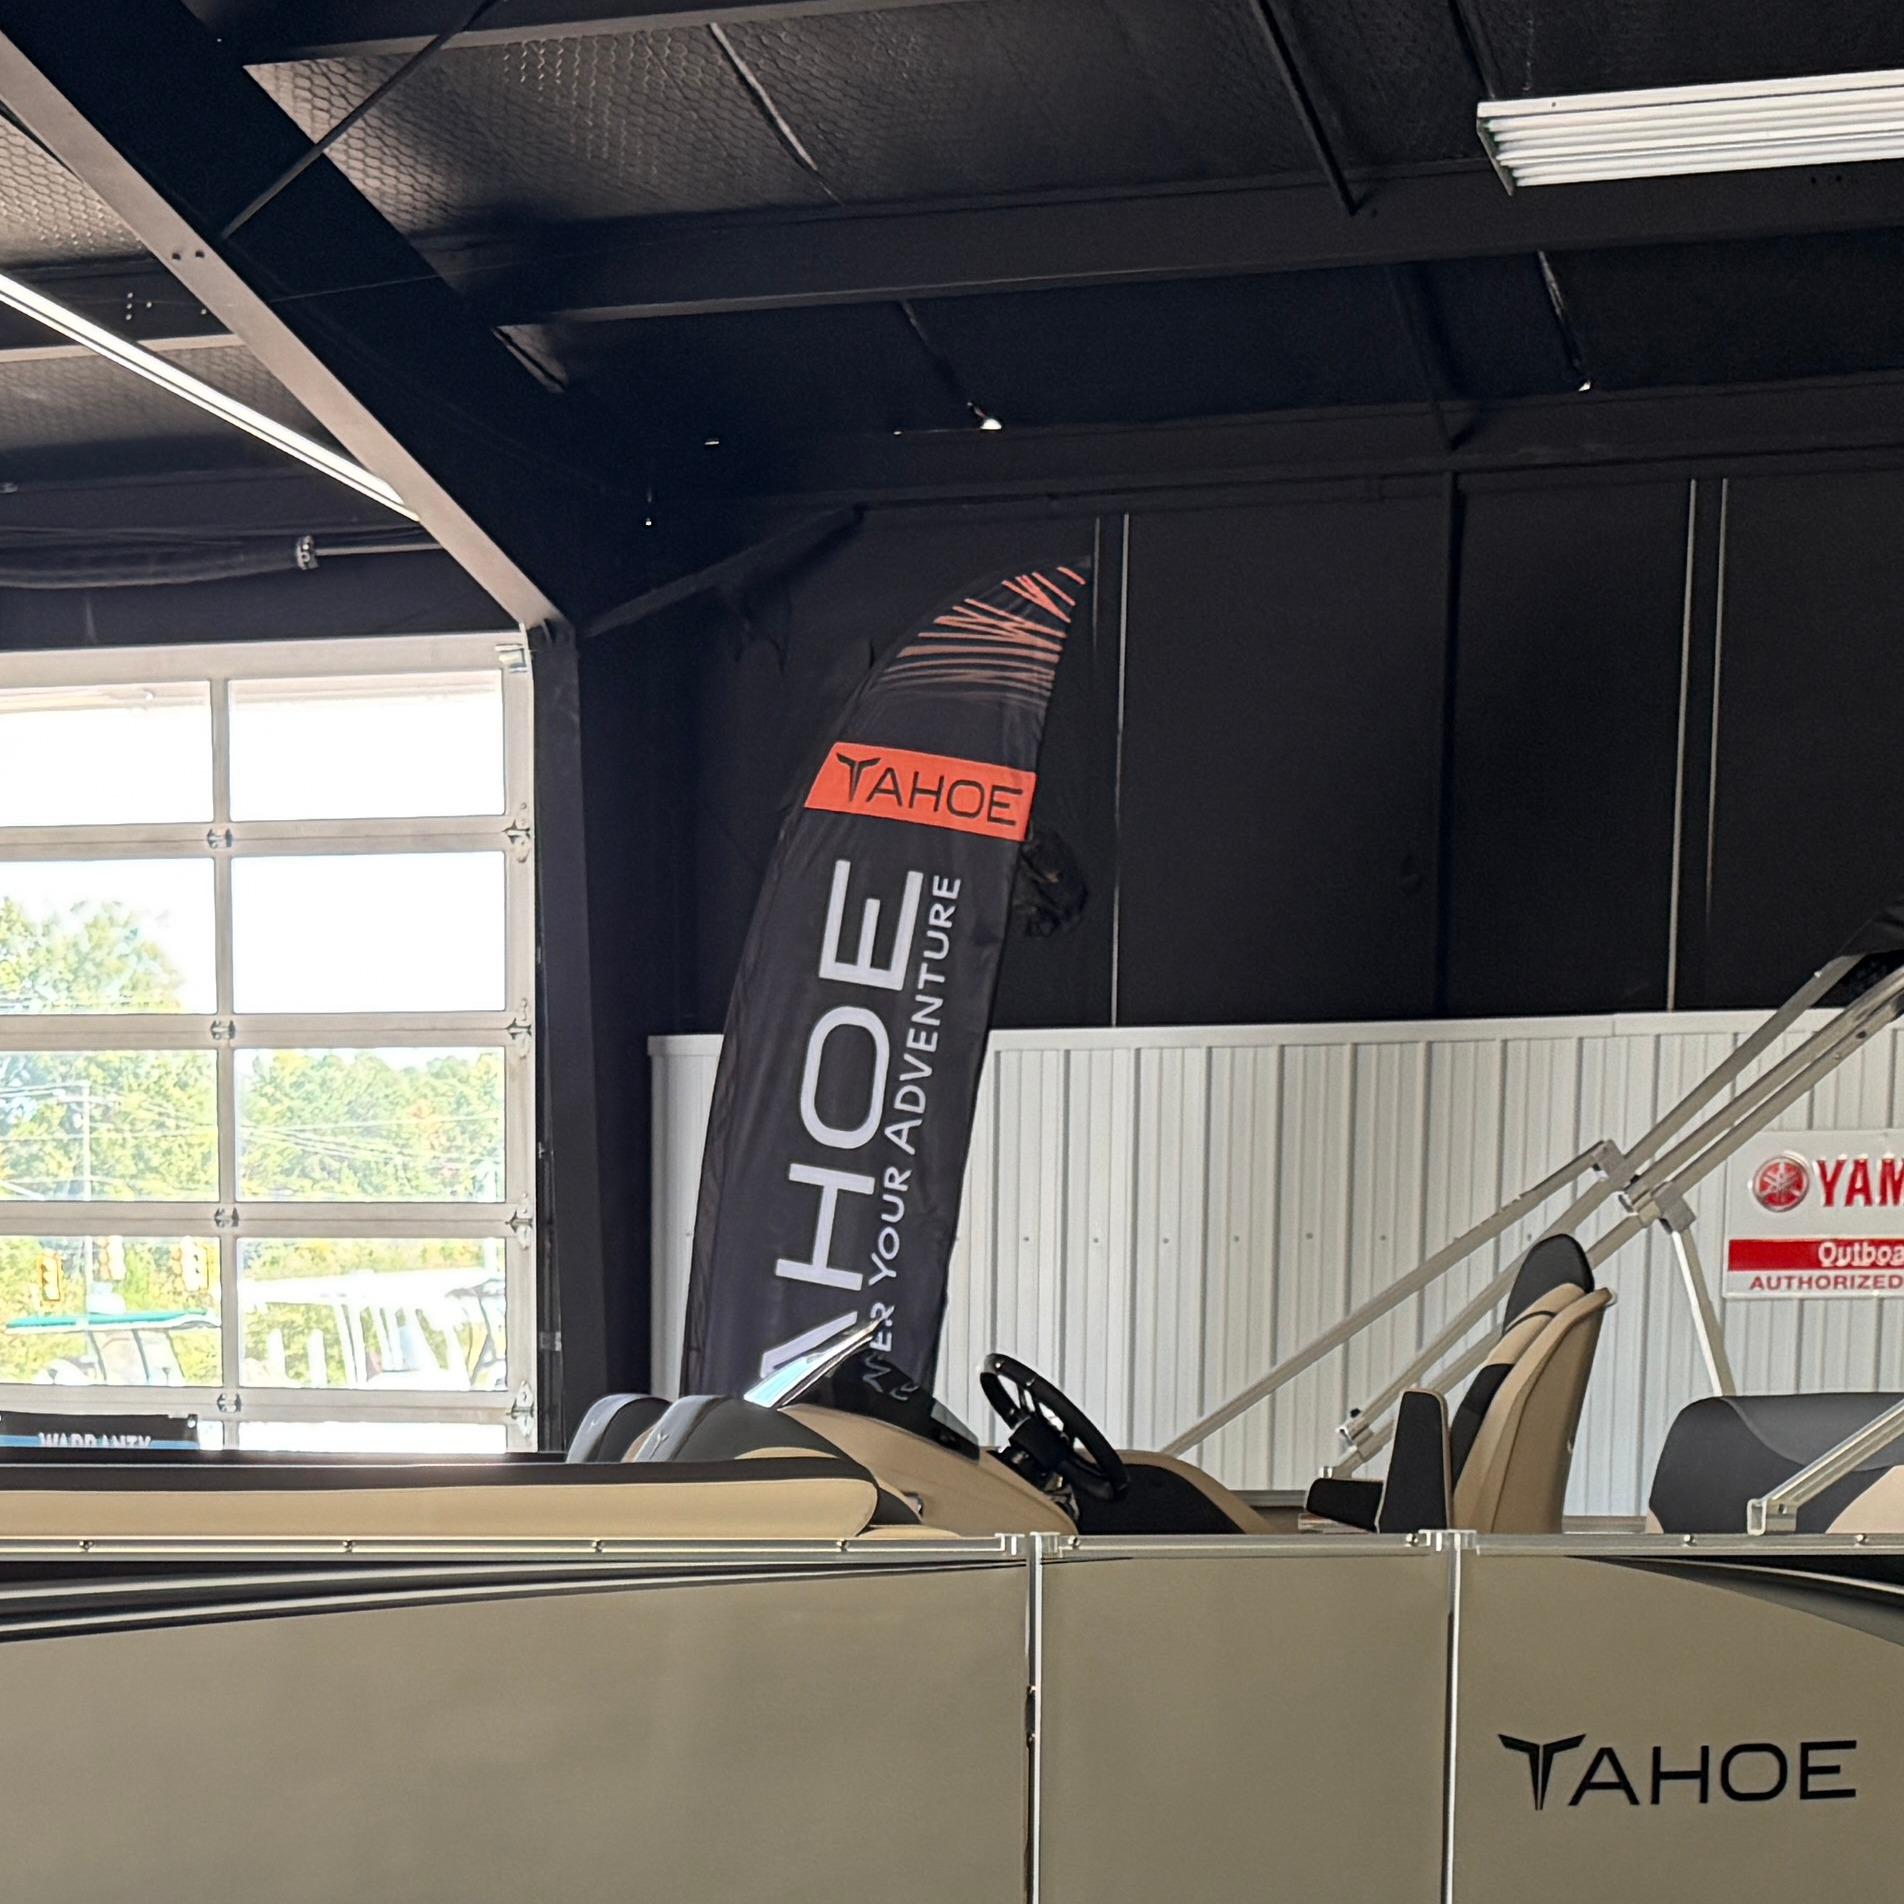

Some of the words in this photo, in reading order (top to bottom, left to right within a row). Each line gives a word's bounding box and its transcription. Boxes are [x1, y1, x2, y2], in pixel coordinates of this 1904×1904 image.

[836, 752, 1025, 827] TAHOE
[884, 875, 961, 1155] ADVENTURE
[868, 1166, 912, 1286] YOUR
[1749, 1273, 1904, 1291] AUTHORIZED
[1498, 1733, 1857, 1811] TAHOE
